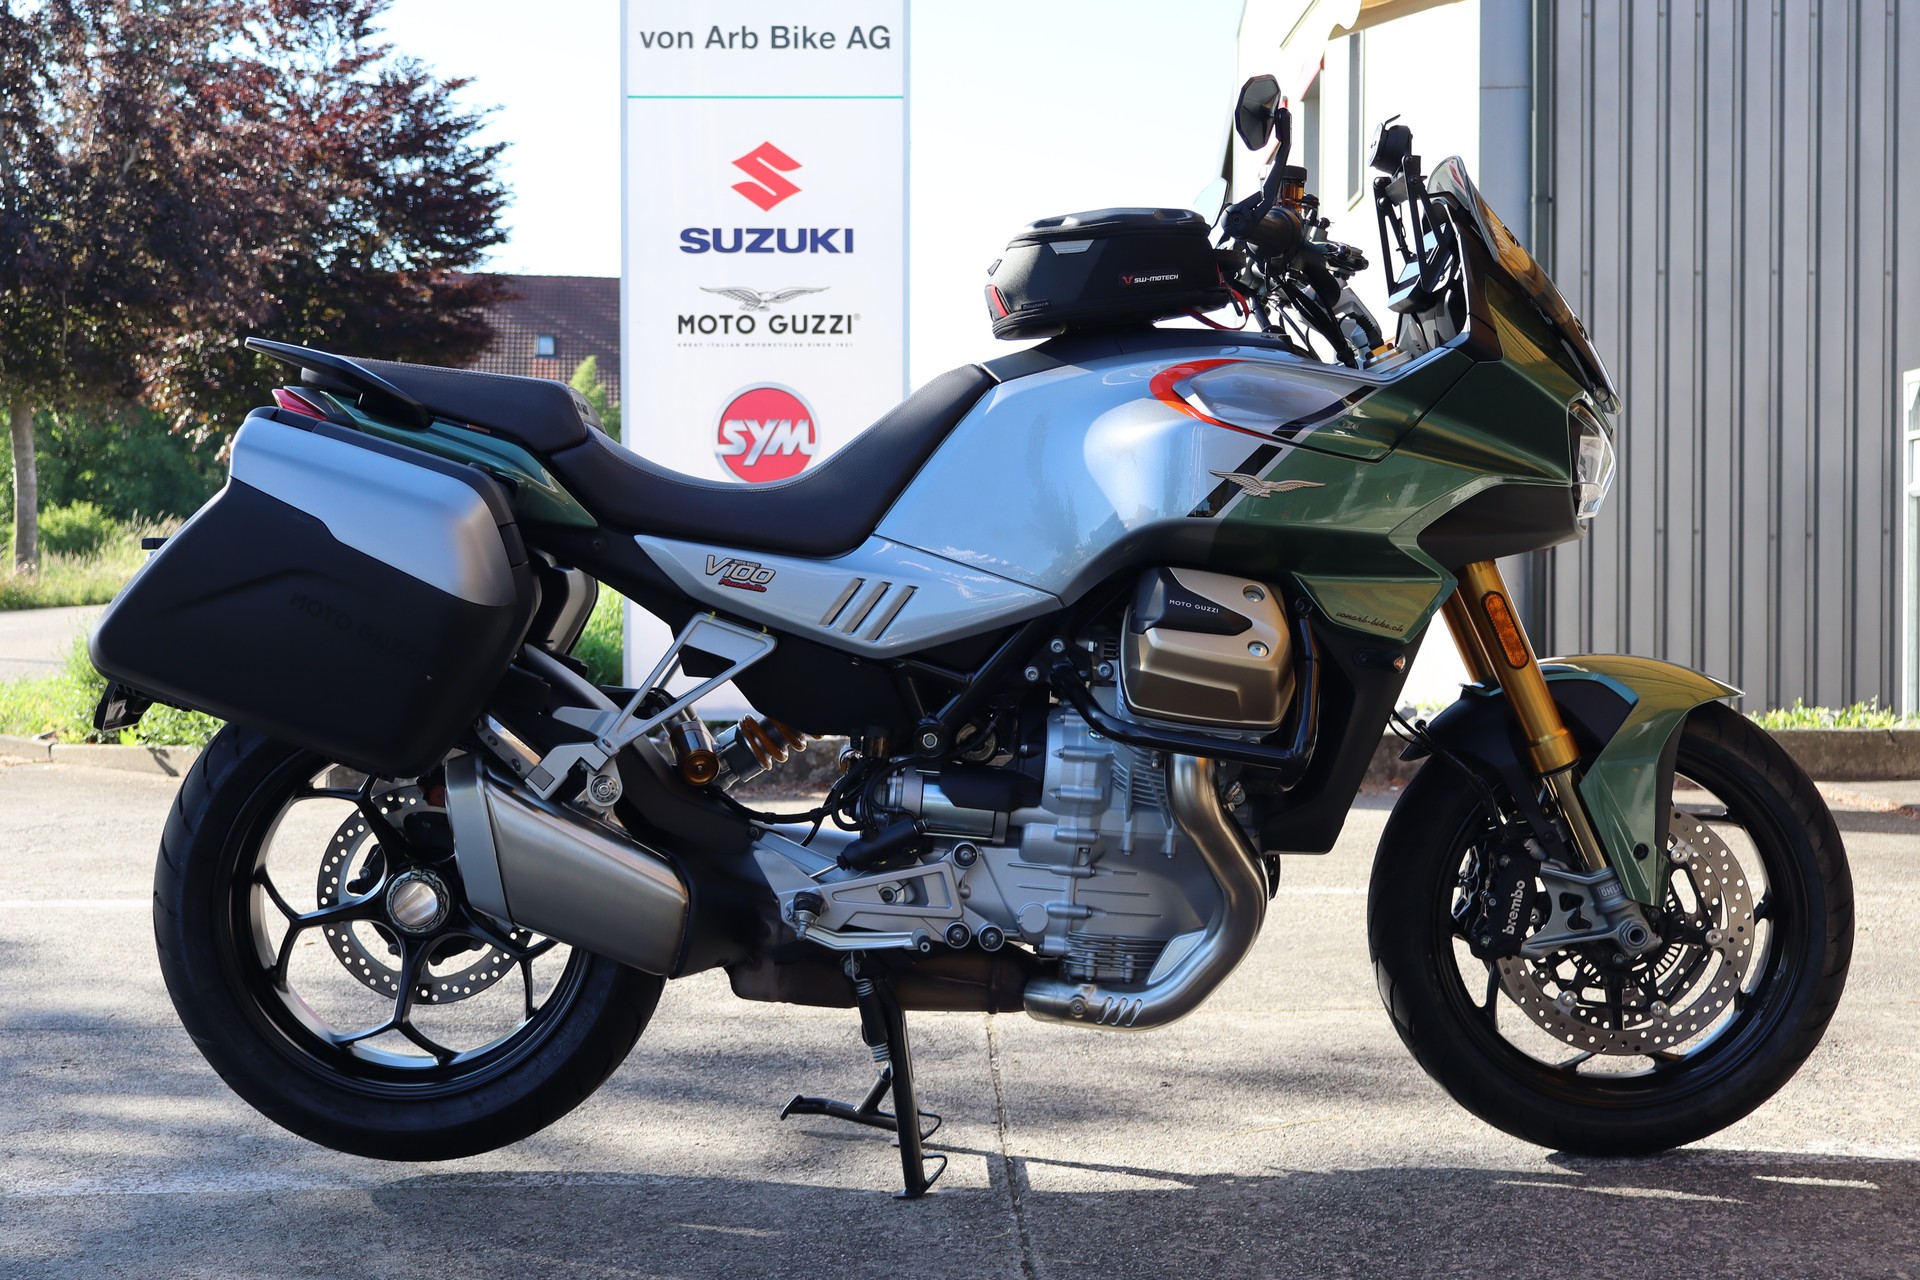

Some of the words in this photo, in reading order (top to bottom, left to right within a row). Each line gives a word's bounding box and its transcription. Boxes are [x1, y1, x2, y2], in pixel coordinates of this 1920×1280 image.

[640, 30, 693, 49] von
[705, 25, 758, 49] Arb
[771, 25, 836, 49] Bike
[847, 25, 891, 49] AG
[679, 227, 854, 254] SUZUKI
[1134, 274, 1179, 284] SW-MOTECH
[677, 314, 755, 334] MOTO
[768, 314, 852, 334] GUZZI
[715, 418, 818, 467] SYM
[705, 554, 776, 585] V100
[1169, 599, 1192, 608] MOTO
[1194, 603, 1219, 614] GUZZI
[1600, 882, 1623, 897] ÖHLI
[1502, 879, 1526, 935] brembo
